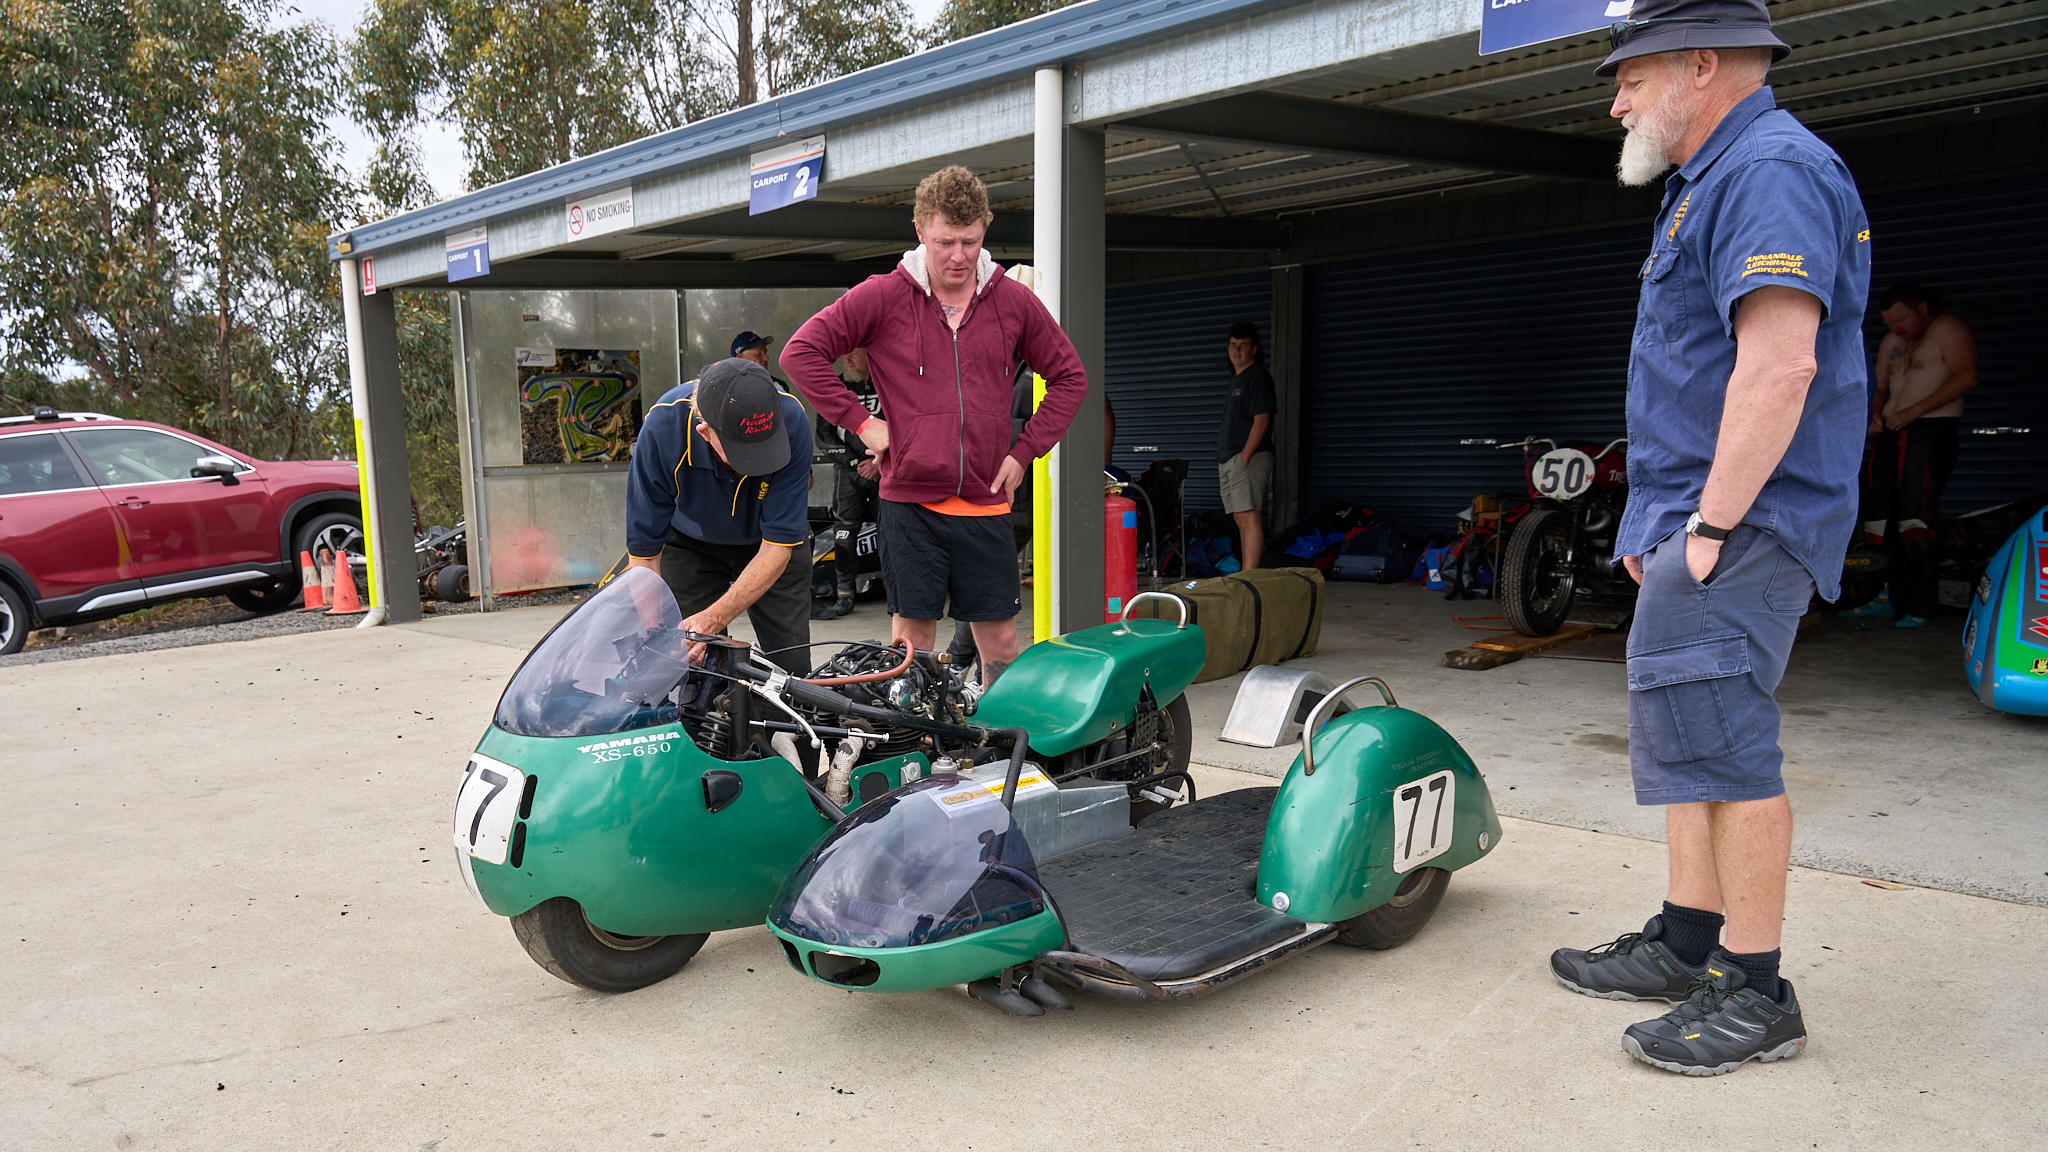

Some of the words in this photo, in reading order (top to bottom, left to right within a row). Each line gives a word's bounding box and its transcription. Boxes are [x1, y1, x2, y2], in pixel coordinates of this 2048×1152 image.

[753, 172, 789, 189] CARPORT
[792, 166, 811, 199] 2
[586, 208, 596, 223] NO
[597, 199, 631, 220] SMOKING
[448, 251, 469, 263] CARPORT
[473, 248, 482, 273] 1
[1741, 266, 1792, 279] Motorcycle
[1791, 267, 1809, 278] Club
[744, 421, 773, 434] Racing
[1540, 457, 1586, 494] 50
[576, 731, 682, 754] YAMAHA
[591, 741, 672, 764] XS-650
[1391, 758, 1415, 772] TEAM
[1416, 746, 1444, 764] FREEMAN
[1411, 758, 1436, 773] RACING
[1400, 775, 1447, 860] 77
